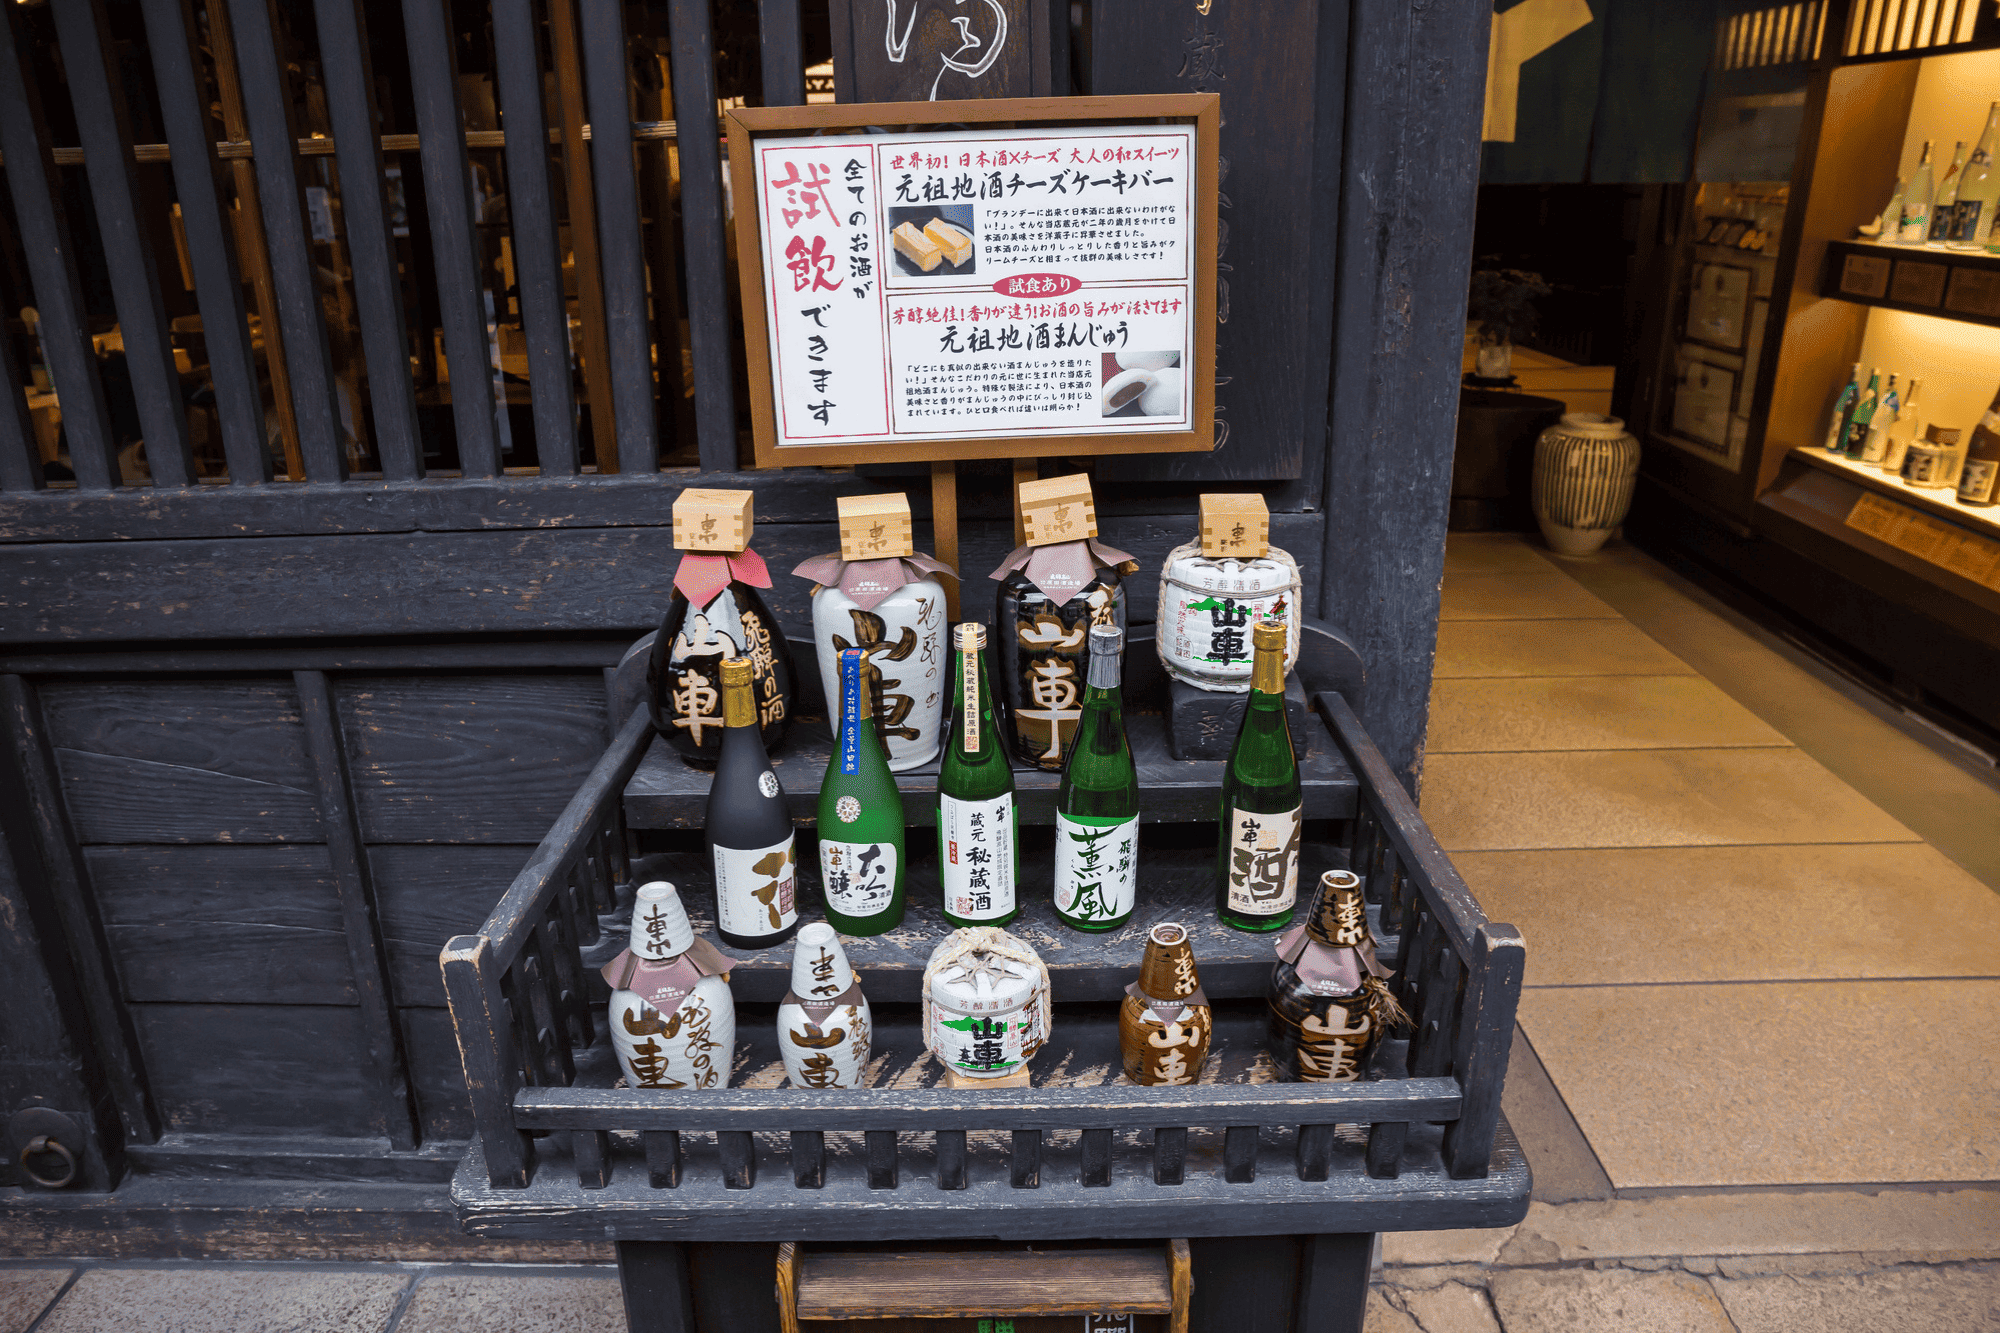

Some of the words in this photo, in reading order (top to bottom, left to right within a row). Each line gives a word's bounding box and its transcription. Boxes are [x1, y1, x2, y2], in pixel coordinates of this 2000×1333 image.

[889, 150, 949, 171] 世界初！
[1070, 146, 1180, 165] 大人の和スイーツ
[895, 168, 1175, 203] 元祖地酒チーズケーキバー
[843, 158, 873, 300] 全てのお酒が
[984, 229, 1145, 243] 本酒の美味さを洋菓子に昇華させました。
[984, 240, 1176, 254] 日本酒のふんわりしっとりした香りと旨みがク
[985, 251, 1164, 265] リームチーズと相まって抜群の美味しさです！
[771, 161, 844, 427] 試飲できます
[1008, 276, 1071, 295] 試食あり
[939, 320, 1129, 354] 元祖地酒まんじゅう
[1206, 598, 1251, 666] 山車
[672, 614, 737, 747] 山車
[1014, 621, 1085, 760] 山車
[966, 812, 992, 911] 蔵元秘蔵酒
[1241, 818, 1261, 848] 山車
[1066, 824, 1120, 920] 薫風
[1230, 890, 1250, 904] 清酒
[623, 1006, 688, 1089] 山車
[790, 1022, 848, 1089] 山車
[970, 1016, 1008, 1070] 山車
[1148, 1021, 1201, 1087] 山車
[1297, 1003, 1371, 1082] 山車
